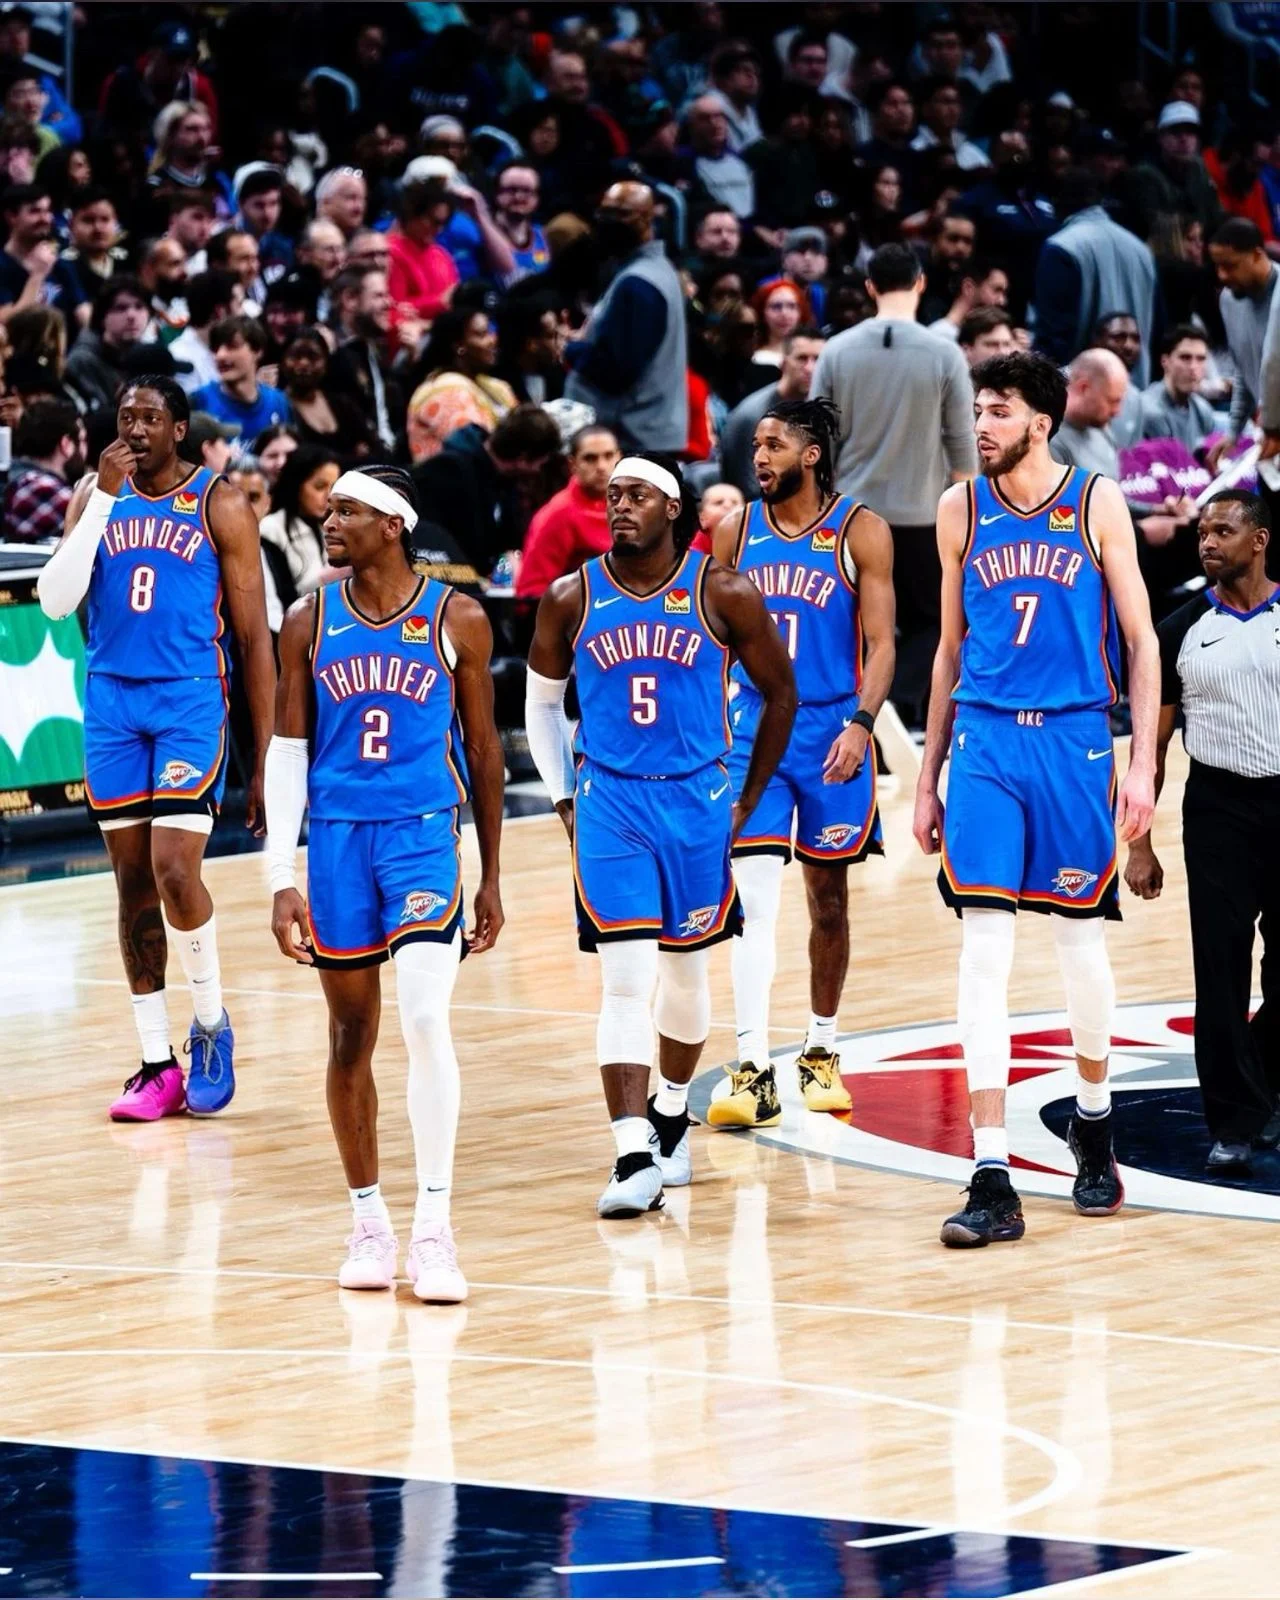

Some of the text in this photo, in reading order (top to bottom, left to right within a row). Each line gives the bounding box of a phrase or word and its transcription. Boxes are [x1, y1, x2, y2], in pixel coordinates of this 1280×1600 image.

[102, 517, 205, 562] THUNDER
[130, 564, 156, 613] 8
[747, 563, 837, 609] HUNDER
[972, 541, 1084, 590] THUNDER
[1014, 594, 1040, 646] 7
[585, 623, 703, 671] THUNDER
[318, 655, 439, 703] THUNDER
[631, 675, 658, 726] 5
[361, 707, 391, 761] 2
[1017, 710, 1044, 727] OKC
